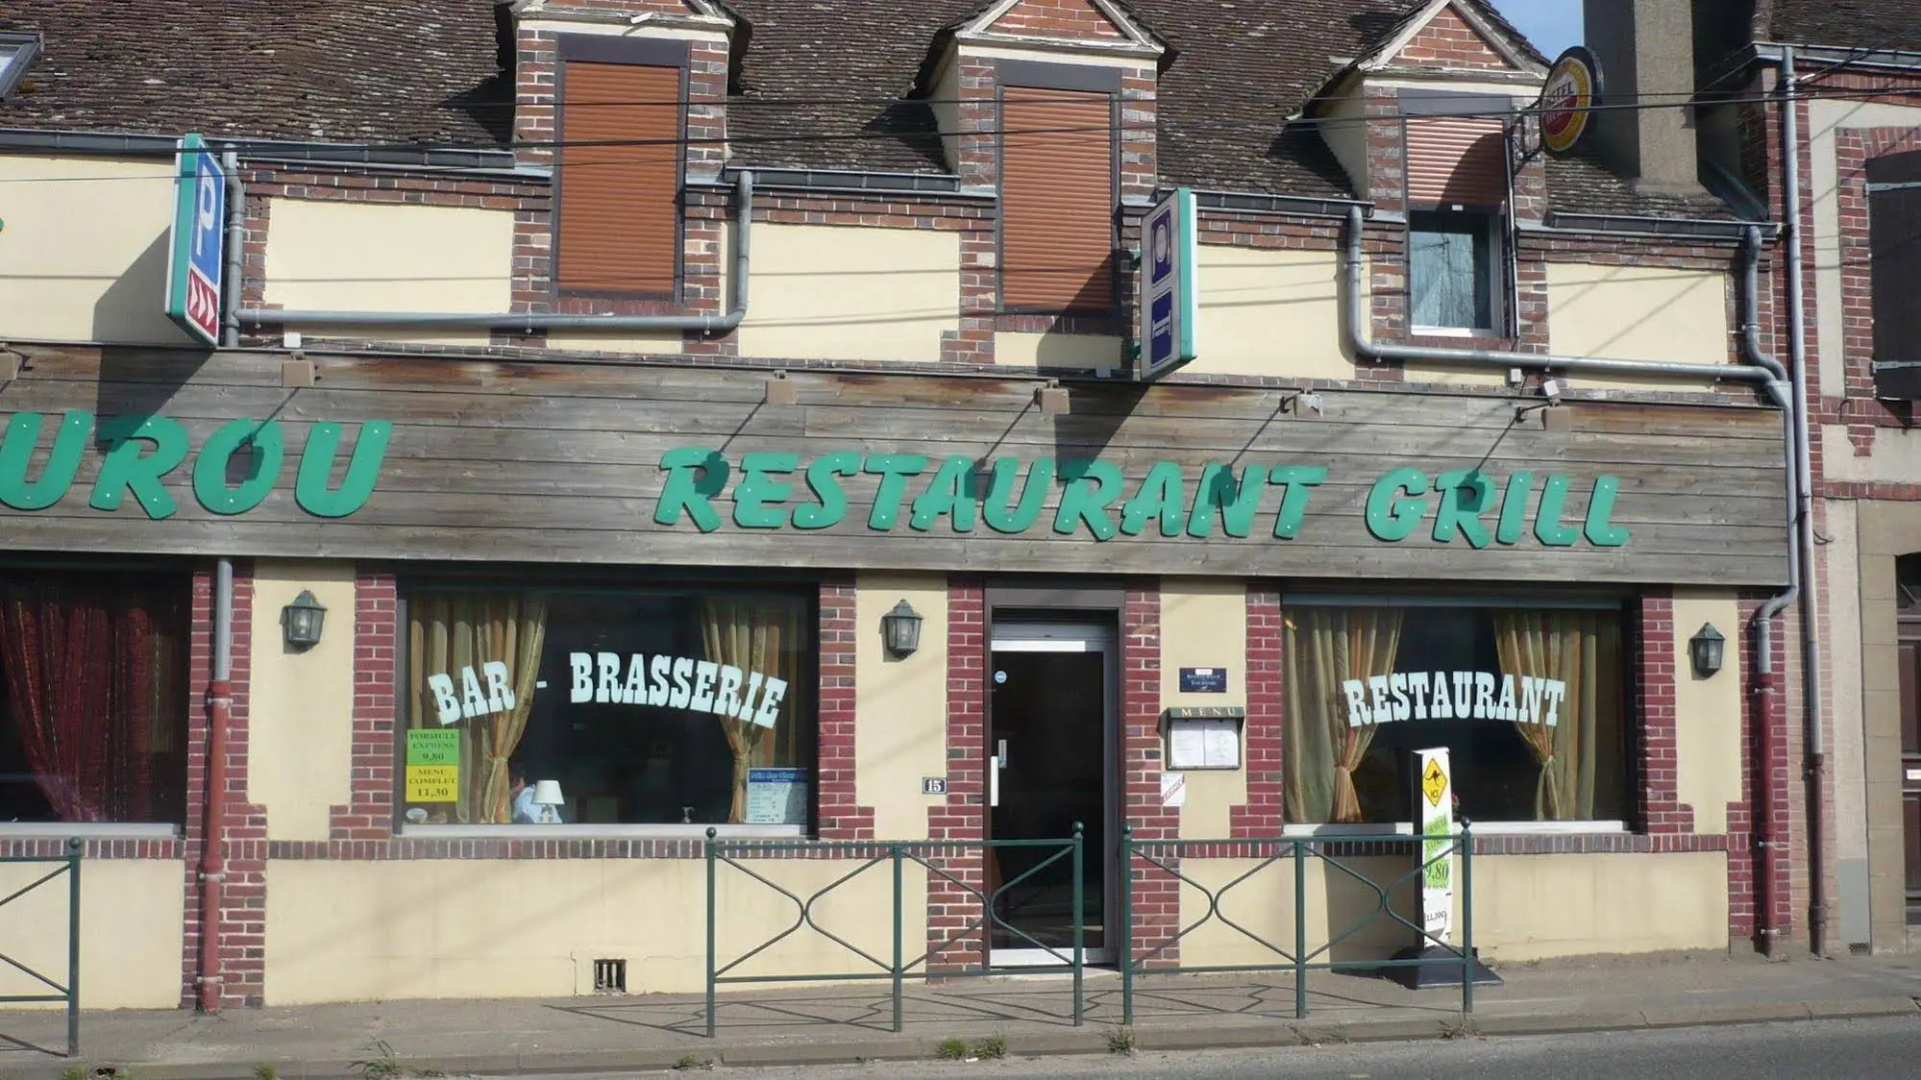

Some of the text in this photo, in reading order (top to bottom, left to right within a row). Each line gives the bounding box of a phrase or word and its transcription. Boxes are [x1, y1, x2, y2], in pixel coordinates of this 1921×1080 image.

[196, 165, 216, 257] P
[0, 409, 393, 521] UROU
[654, 445, 1632, 550] RESTAURANT GRILL
[427, 660, 516, 726] BAR
[570, 651, 788, 730] BRASSERIE
[1181, 706, 1235, 718] MENU
[1342, 670, 1566, 727] RESTAURANT
